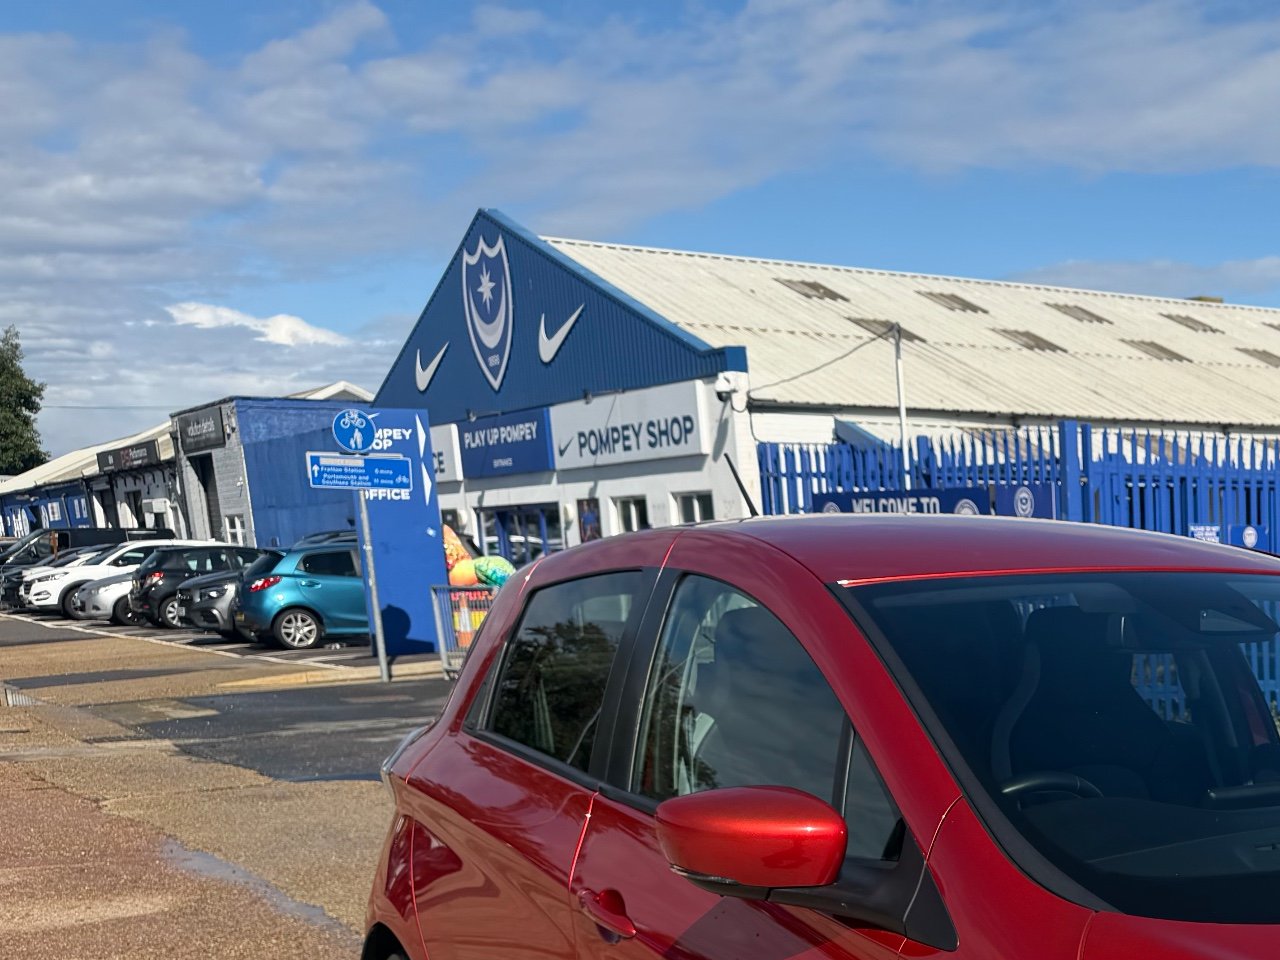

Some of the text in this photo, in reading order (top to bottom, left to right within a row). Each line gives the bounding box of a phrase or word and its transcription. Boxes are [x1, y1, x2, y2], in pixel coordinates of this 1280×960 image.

[464, 421, 538, 449] PLAY UP POMPEY
[577, 415, 695, 457] POMPEY SHOP
[920, 497, 941, 513] TO
